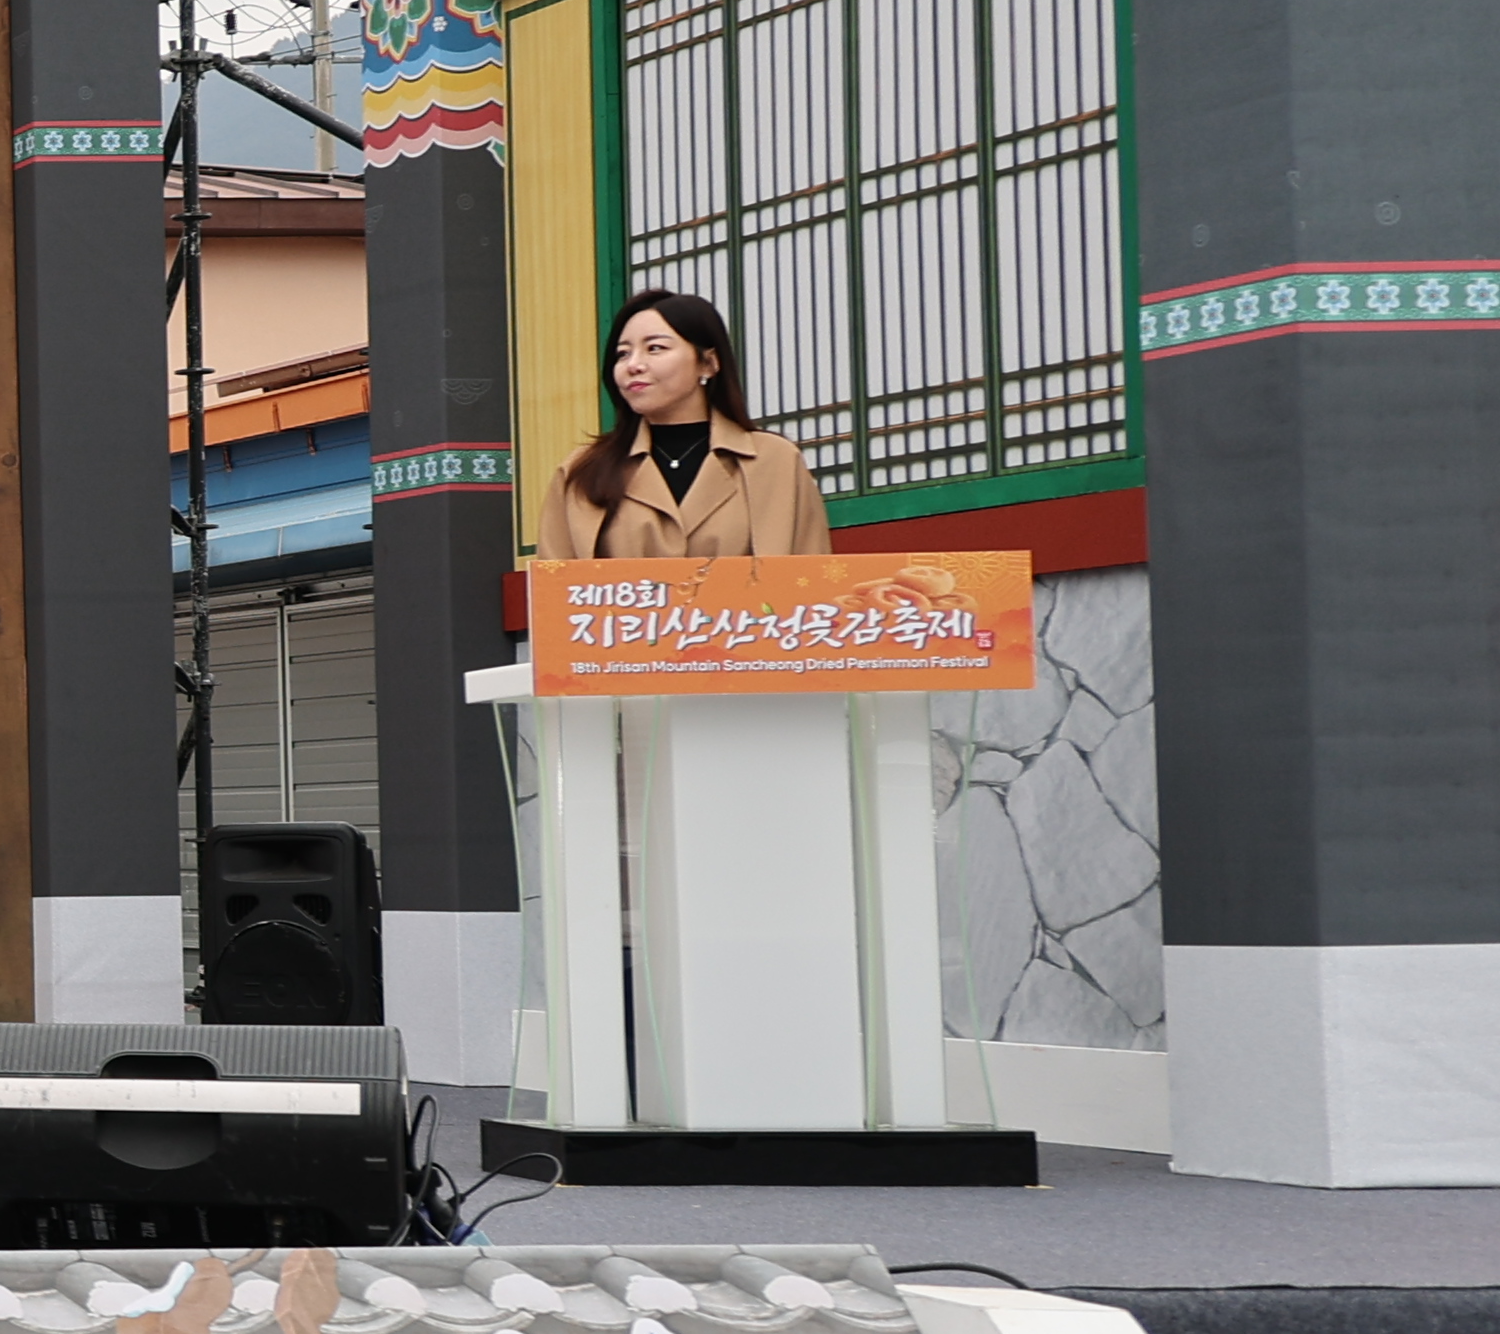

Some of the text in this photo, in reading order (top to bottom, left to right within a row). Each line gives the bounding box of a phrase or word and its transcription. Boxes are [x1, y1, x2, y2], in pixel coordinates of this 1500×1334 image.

[567, 579, 667, 608] 제18회
[571, 654, 989, 674] 18th Jirisan Mountain Sancheong Dried Persimmon Festival
